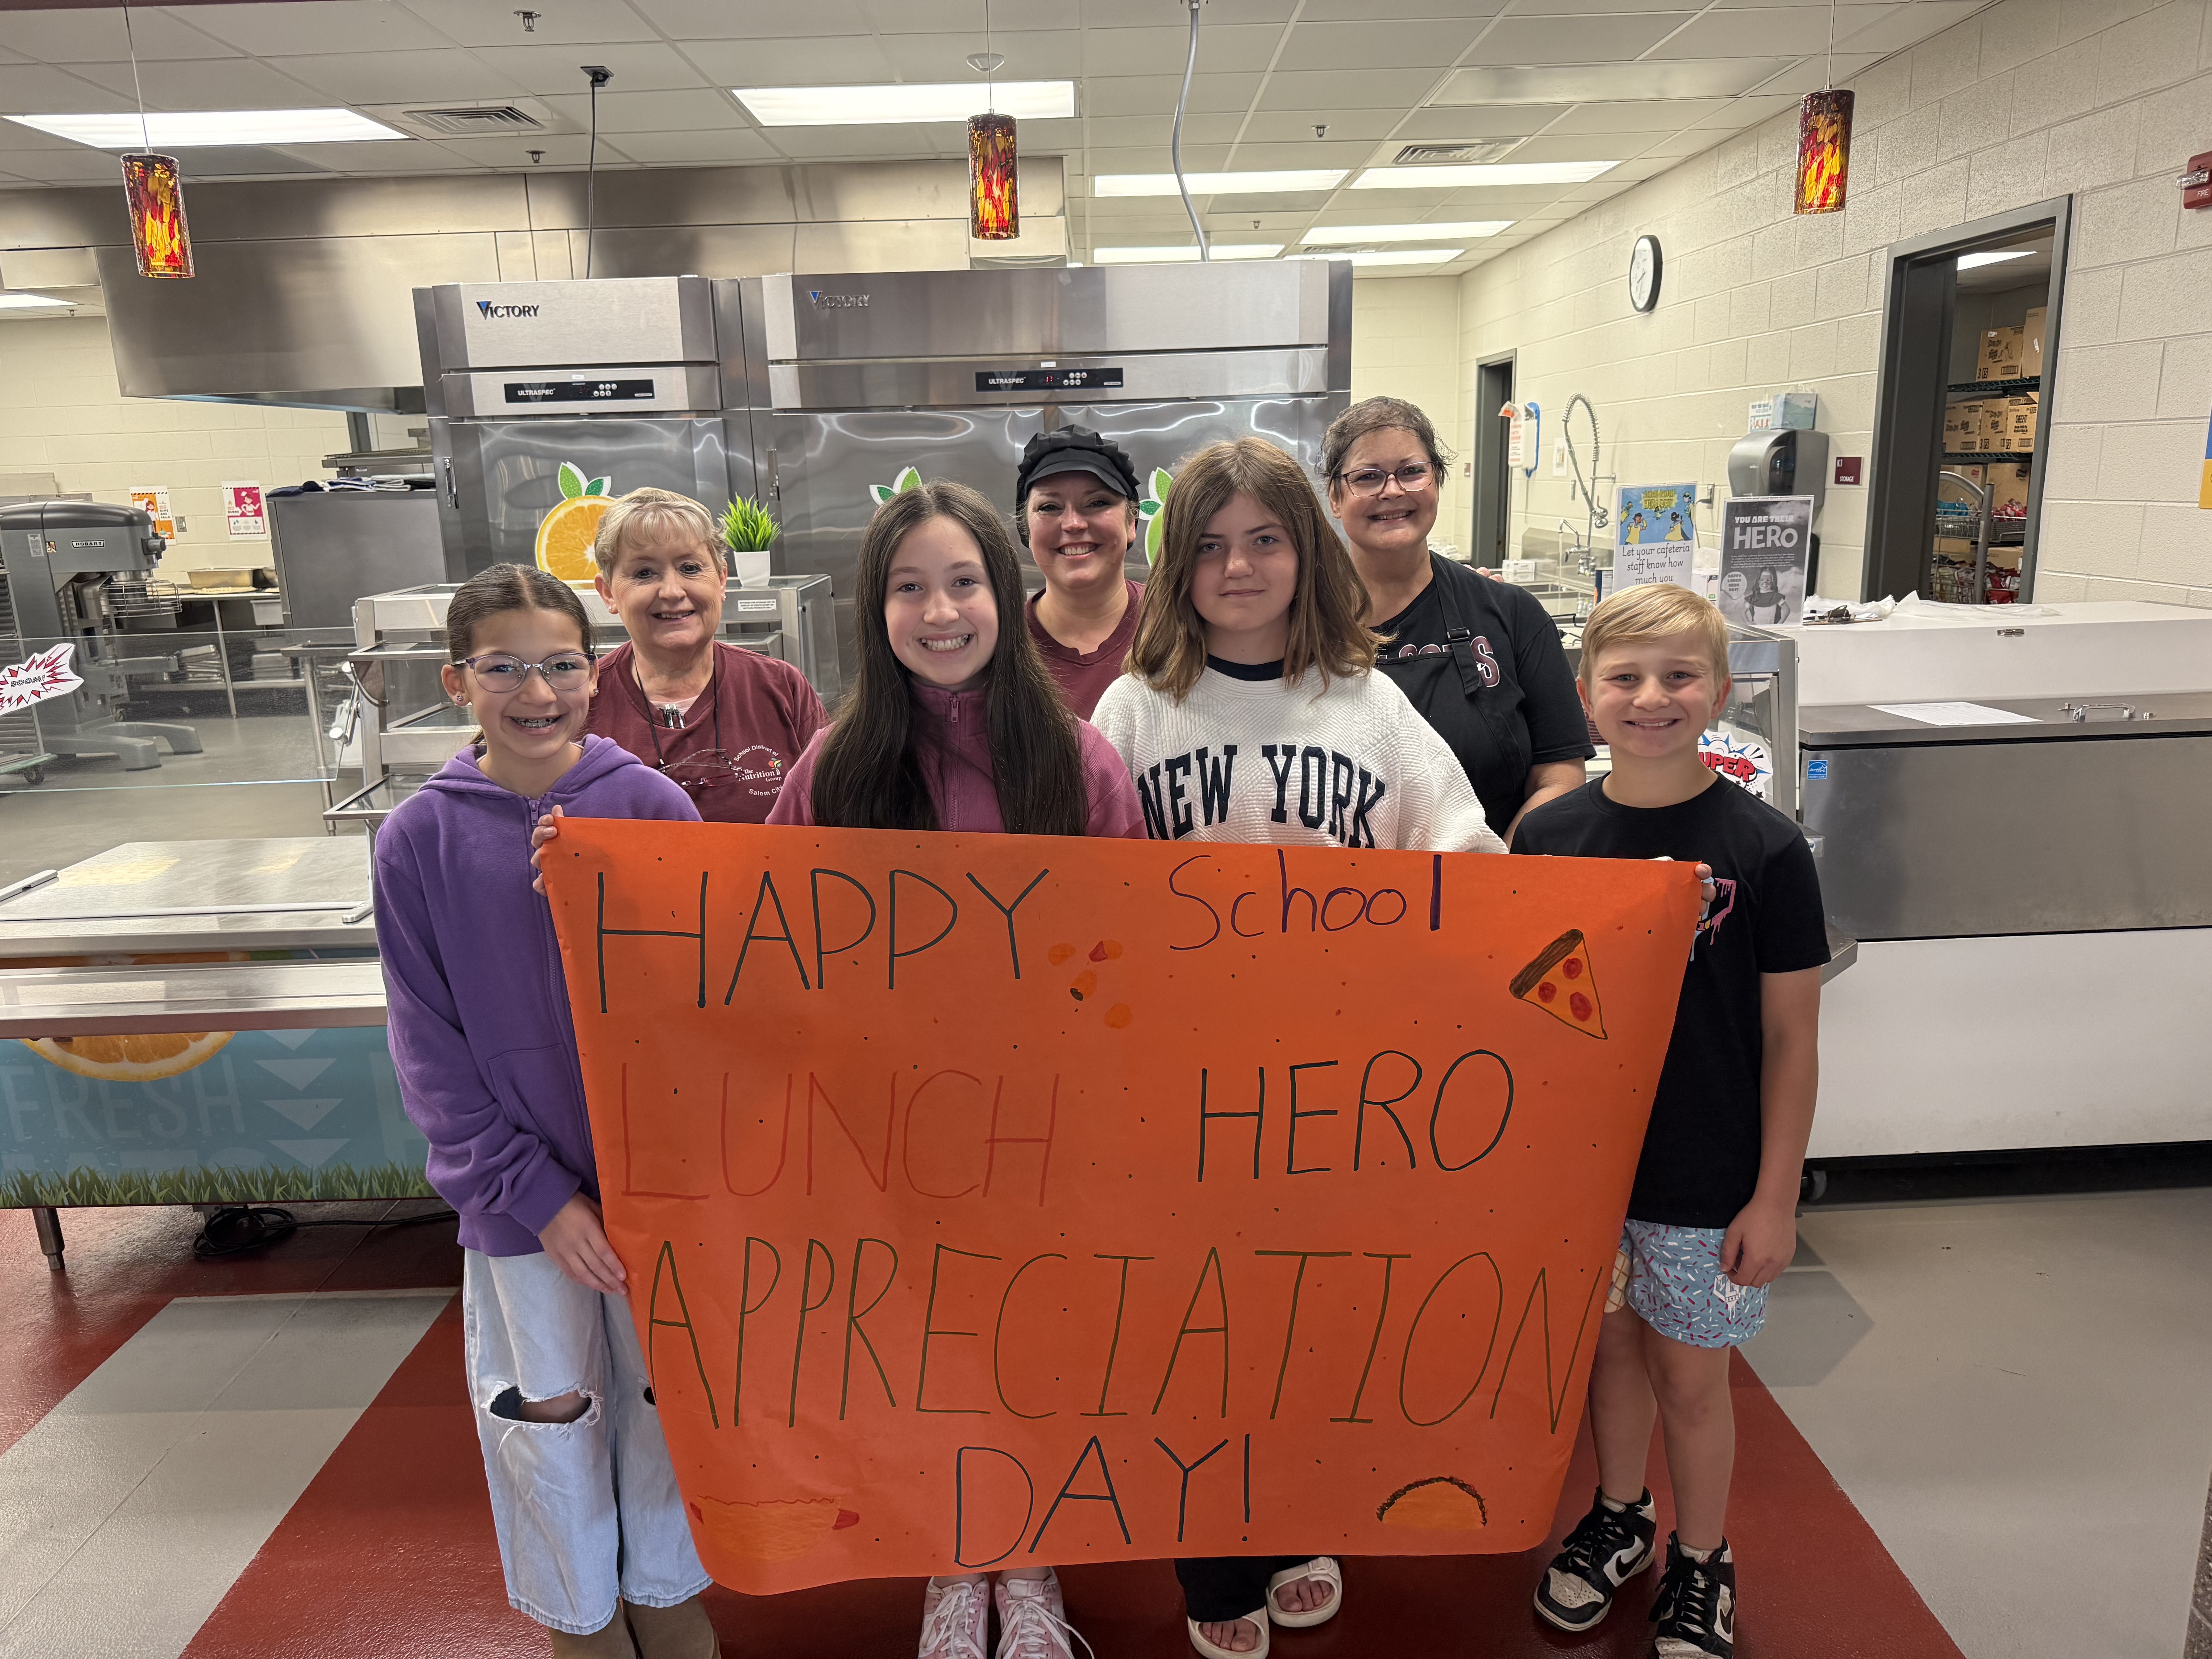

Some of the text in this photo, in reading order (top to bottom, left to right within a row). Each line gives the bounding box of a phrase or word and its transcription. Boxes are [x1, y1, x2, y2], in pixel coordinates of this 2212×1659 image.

[2197, 189, 2209, 197] FIRE
[476, 301, 539, 320] VICTORY
[805, 291, 870, 311] VICTORY
[1733, 525, 1798, 550] HERO
[1622, 543, 1690, 560] Let your cafeteria
[1627, 557, 1683, 574] staff know how
[1635, 573, 1657, 584] much
[10, 675, 45, 688] BOOM!
[734, 747, 751, 762] School
[751, 745, 773, 753] District
[1698, 752, 1756, 782] UPER
[771, 785, 783, 794] City
[1137, 743, 1386, 848] NEW YORK
[598, 848, 1441, 1014] HAPPY School
[0, 1055, 246, 1142] FRESH
[621, 1049, 1514, 1207] LUNCH HERO
[648, 1237, 1603, 1434] APPRECIATION
[953, 1433, 1250, 1568] DAY!
